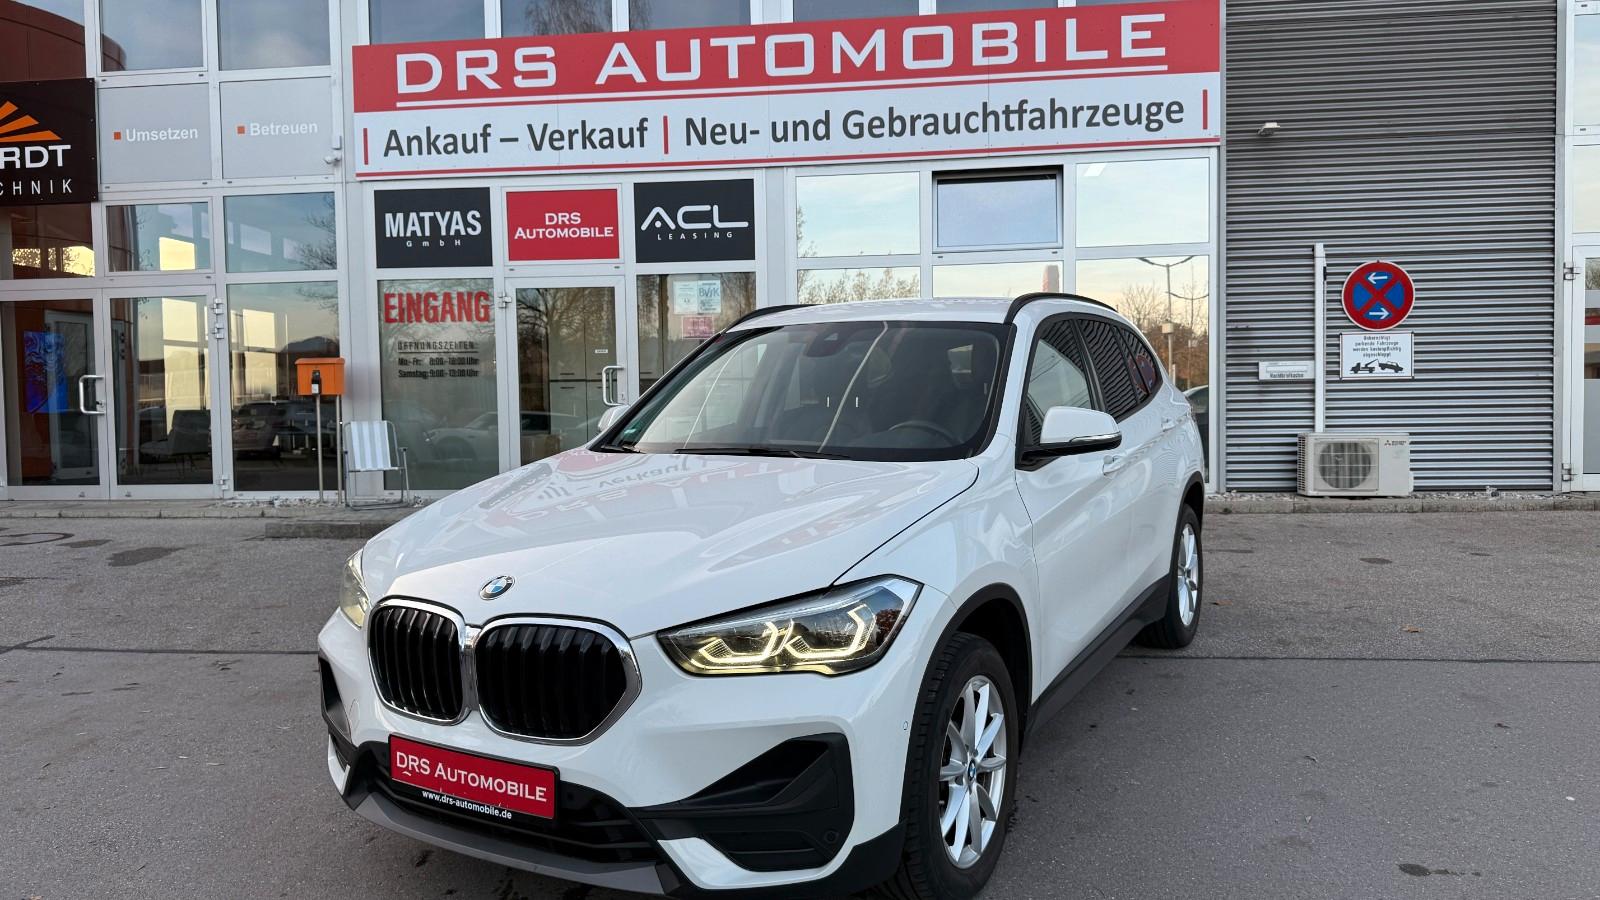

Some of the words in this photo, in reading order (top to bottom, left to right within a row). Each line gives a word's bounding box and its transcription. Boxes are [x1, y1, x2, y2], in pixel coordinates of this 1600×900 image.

[397, 46, 557, 94] DRS
[594, 13, 1166, 85] AUTOMOBILE
[126, 126, 198, 142] Umsetzen
[250, 121, 318, 137] Betreuen
[383, 123, 491, 157] Ankauf
[527, 117, 649, 151] Verkauf
[685, 116, 760, 147] Neu-
[771, 110, 831, 144] und
[843, 97, 1185, 138] Gebrauchtfahrzeuge
[0, 144, 72, 169] RDT
[385, 209, 482, 238] MATYAS
[545, 212, 581, 225] DRS
[640, 204, 749, 231] ACL
[514, 226, 614, 240] AUTOMOBILE
[657, 231, 733, 241] LEASING
[384, 291, 490, 324] EINGANG
[396, 751, 430, 775] DRS
[435, 762, 547, 802] AUTOMOBILE
[421, 790, 512, 820] www.drs-automobile.de
